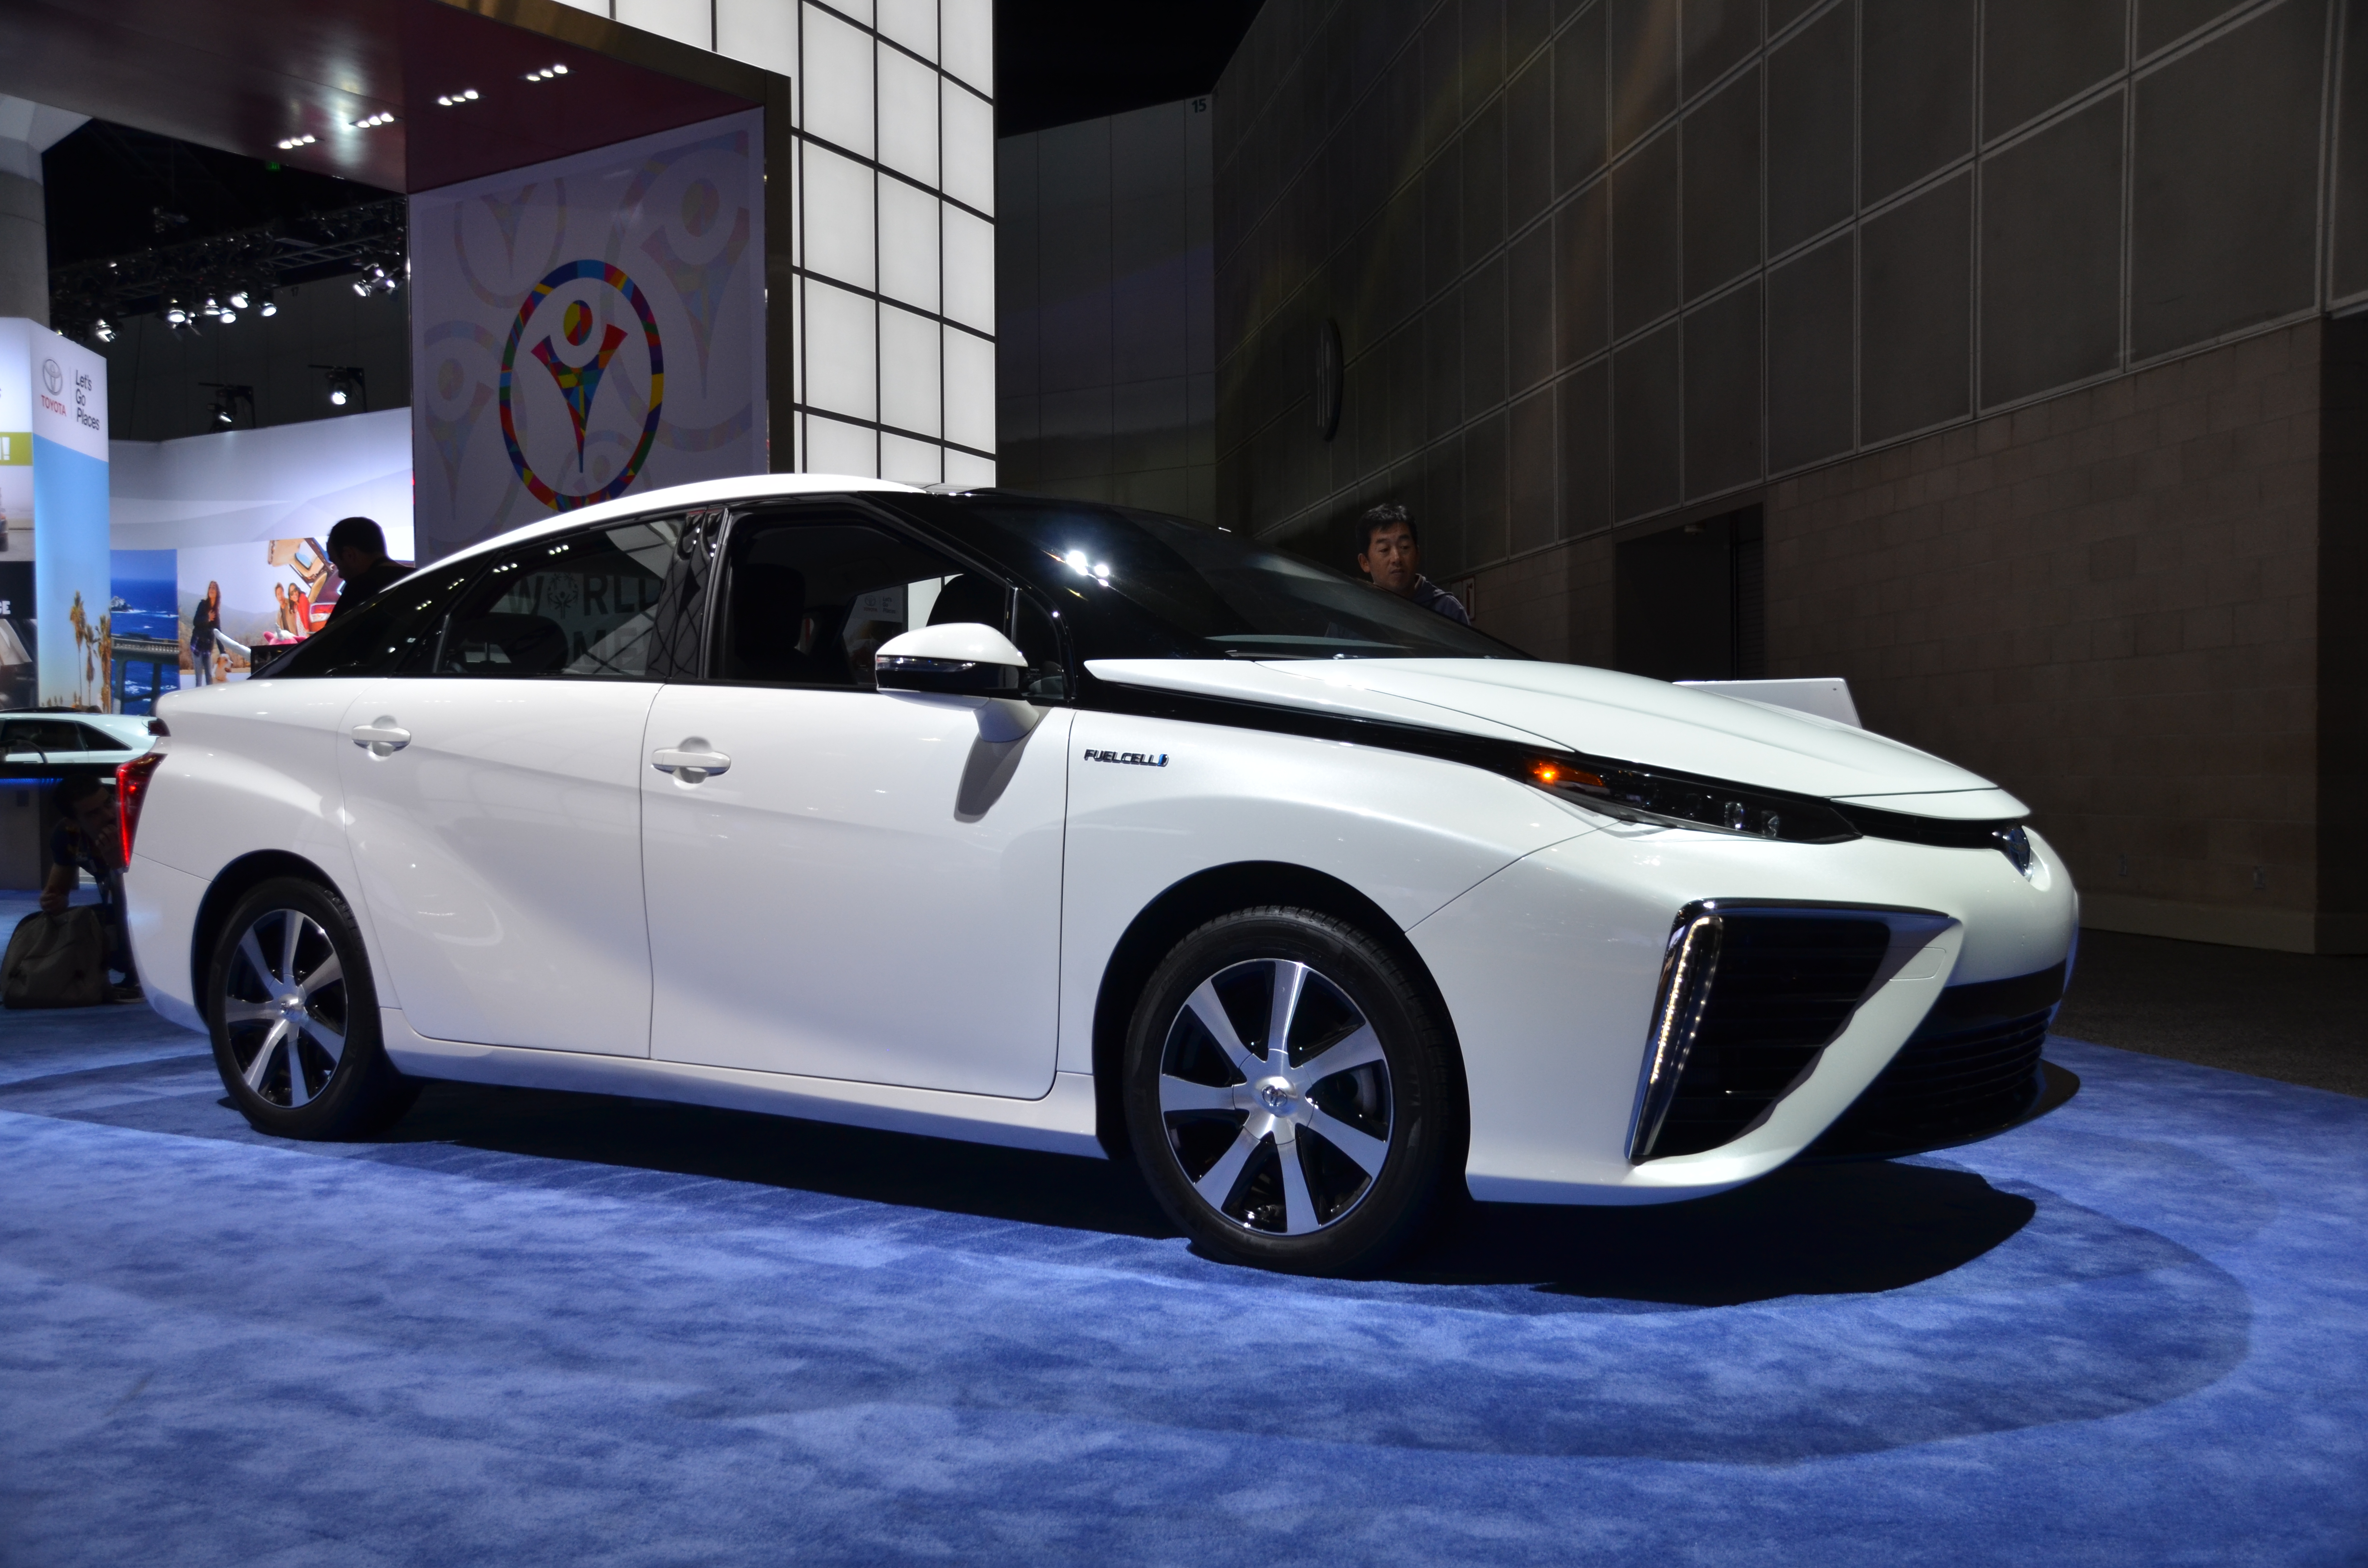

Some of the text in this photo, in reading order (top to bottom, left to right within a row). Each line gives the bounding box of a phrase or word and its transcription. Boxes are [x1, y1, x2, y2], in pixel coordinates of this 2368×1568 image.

[1191, 98, 1207, 113] 15
[291, 286, 299, 297] 17
[76, 369, 92, 391] Let's
[41, 394, 66, 416] TOYOTA
[76, 388, 86, 406] Go
[77, 407, 100, 430] Places
[1084, 749, 1158, 767] FUELCELL
